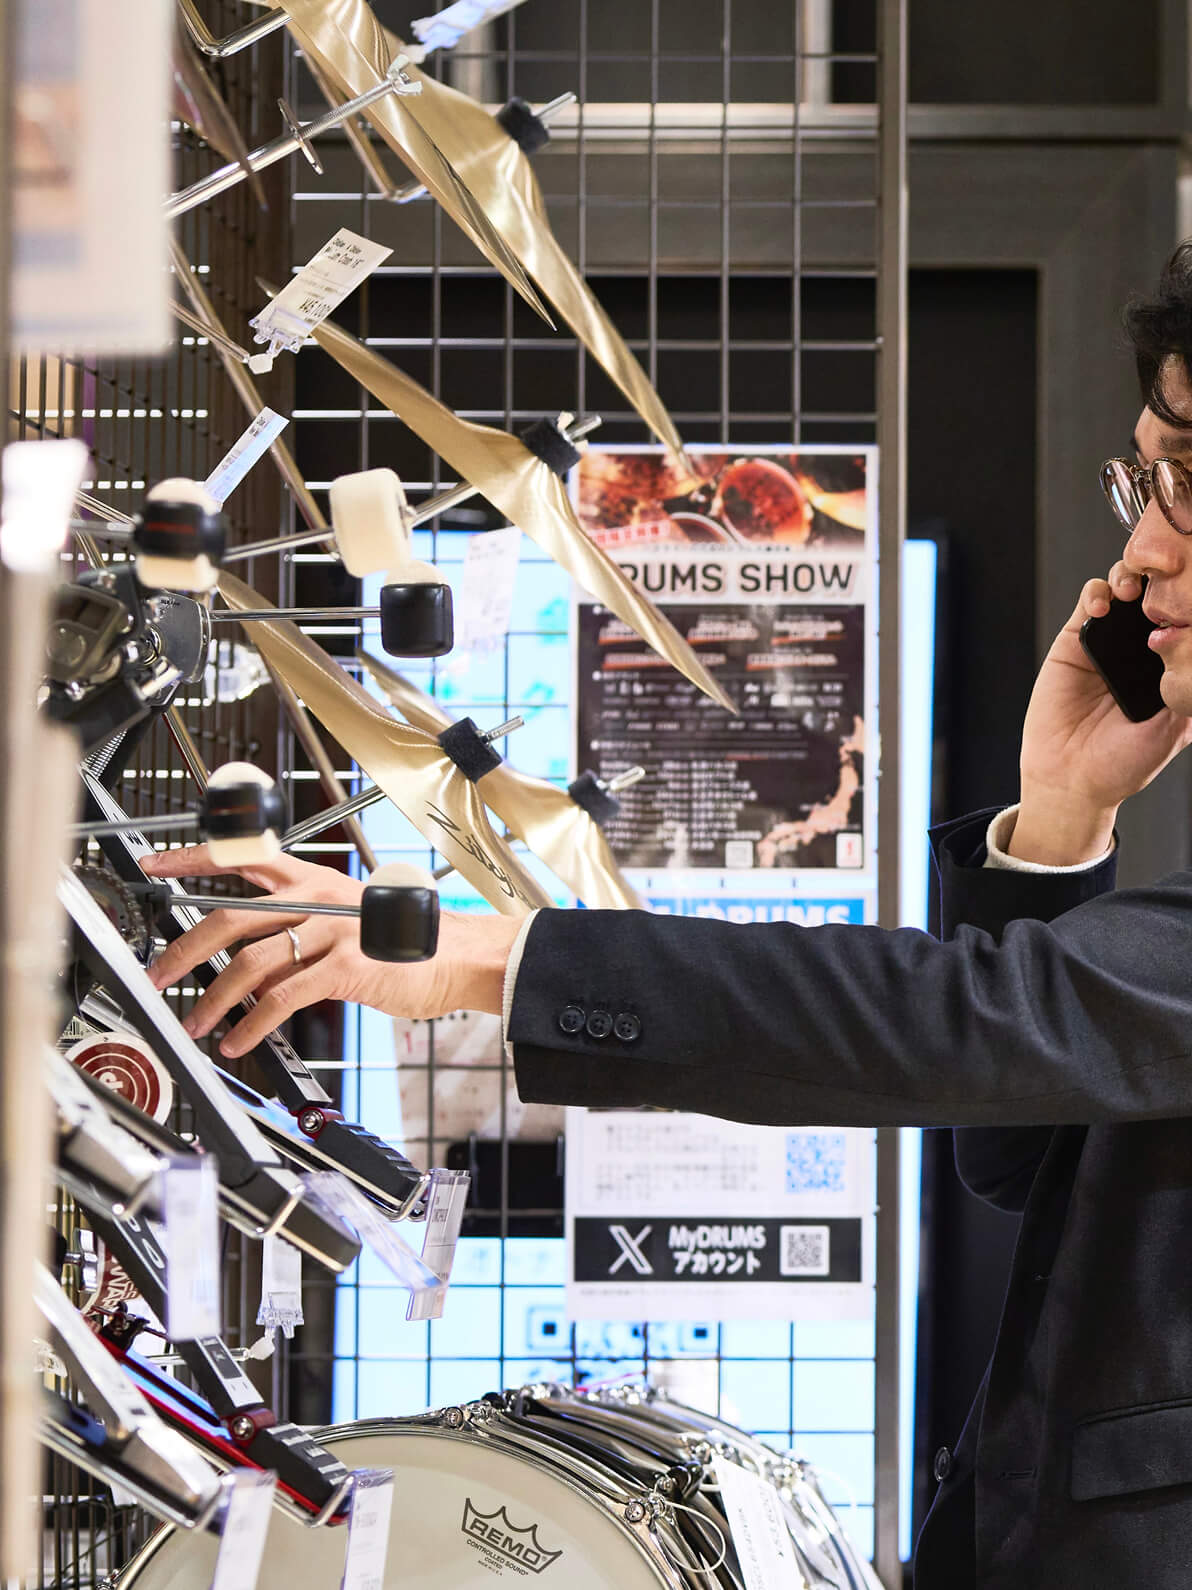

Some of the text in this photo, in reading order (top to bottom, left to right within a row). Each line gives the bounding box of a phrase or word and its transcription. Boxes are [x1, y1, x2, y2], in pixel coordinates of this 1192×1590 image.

[740, 563, 853, 592] SHOW
[668, 1225, 767, 1253] MyDRUMS
[673, 1251, 761, 1275] アカウント
[466, 1538, 505, 1564] CONTROLLED
[469, 1517, 541, 1566] REMO
